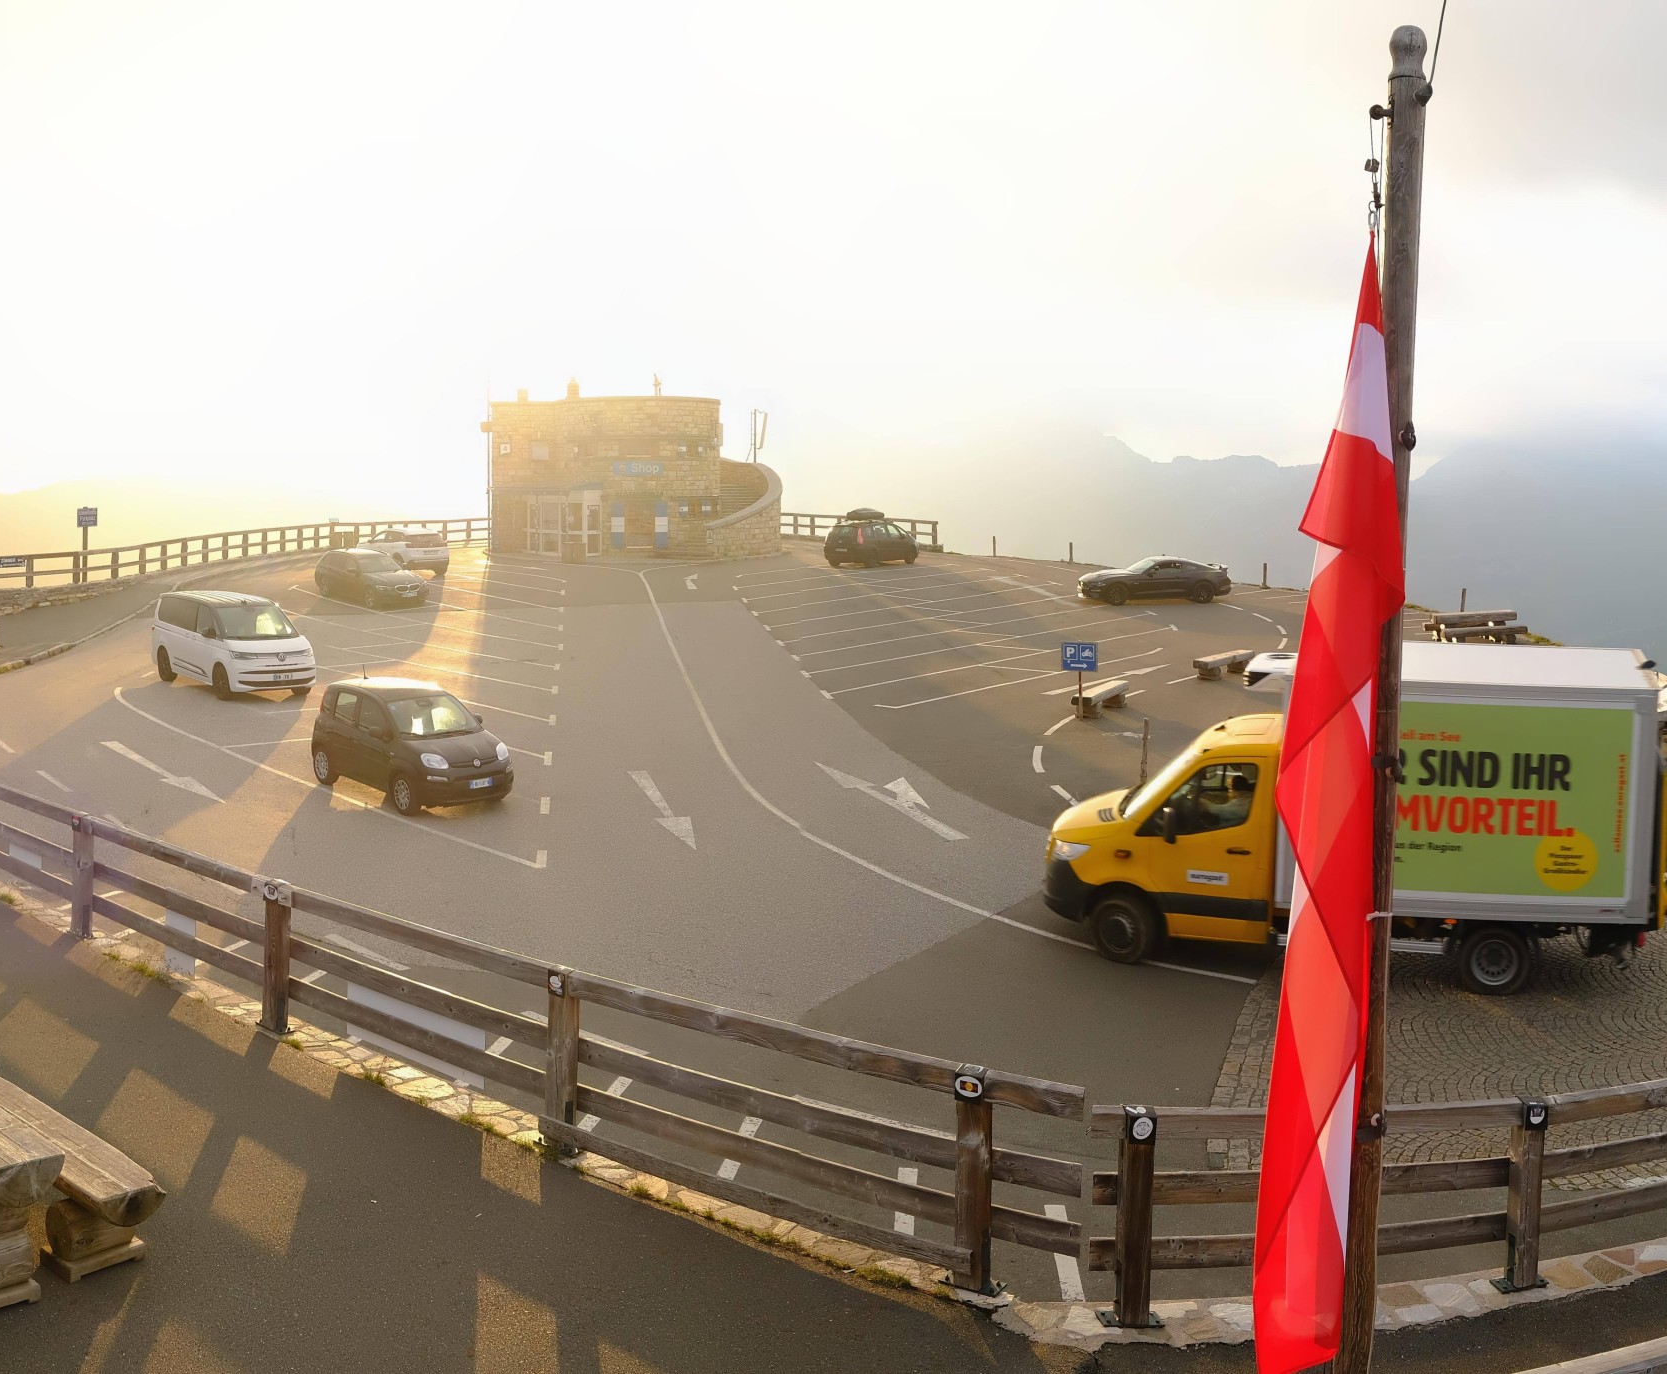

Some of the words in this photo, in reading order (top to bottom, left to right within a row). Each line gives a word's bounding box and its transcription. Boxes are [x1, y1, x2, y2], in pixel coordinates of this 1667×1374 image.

[631, 463, 660, 474] Shop
[1066, 646, 1075, 658] P
[1418, 748, 1500, 789] SIND
[1512, 752, 1572, 792] IHR
